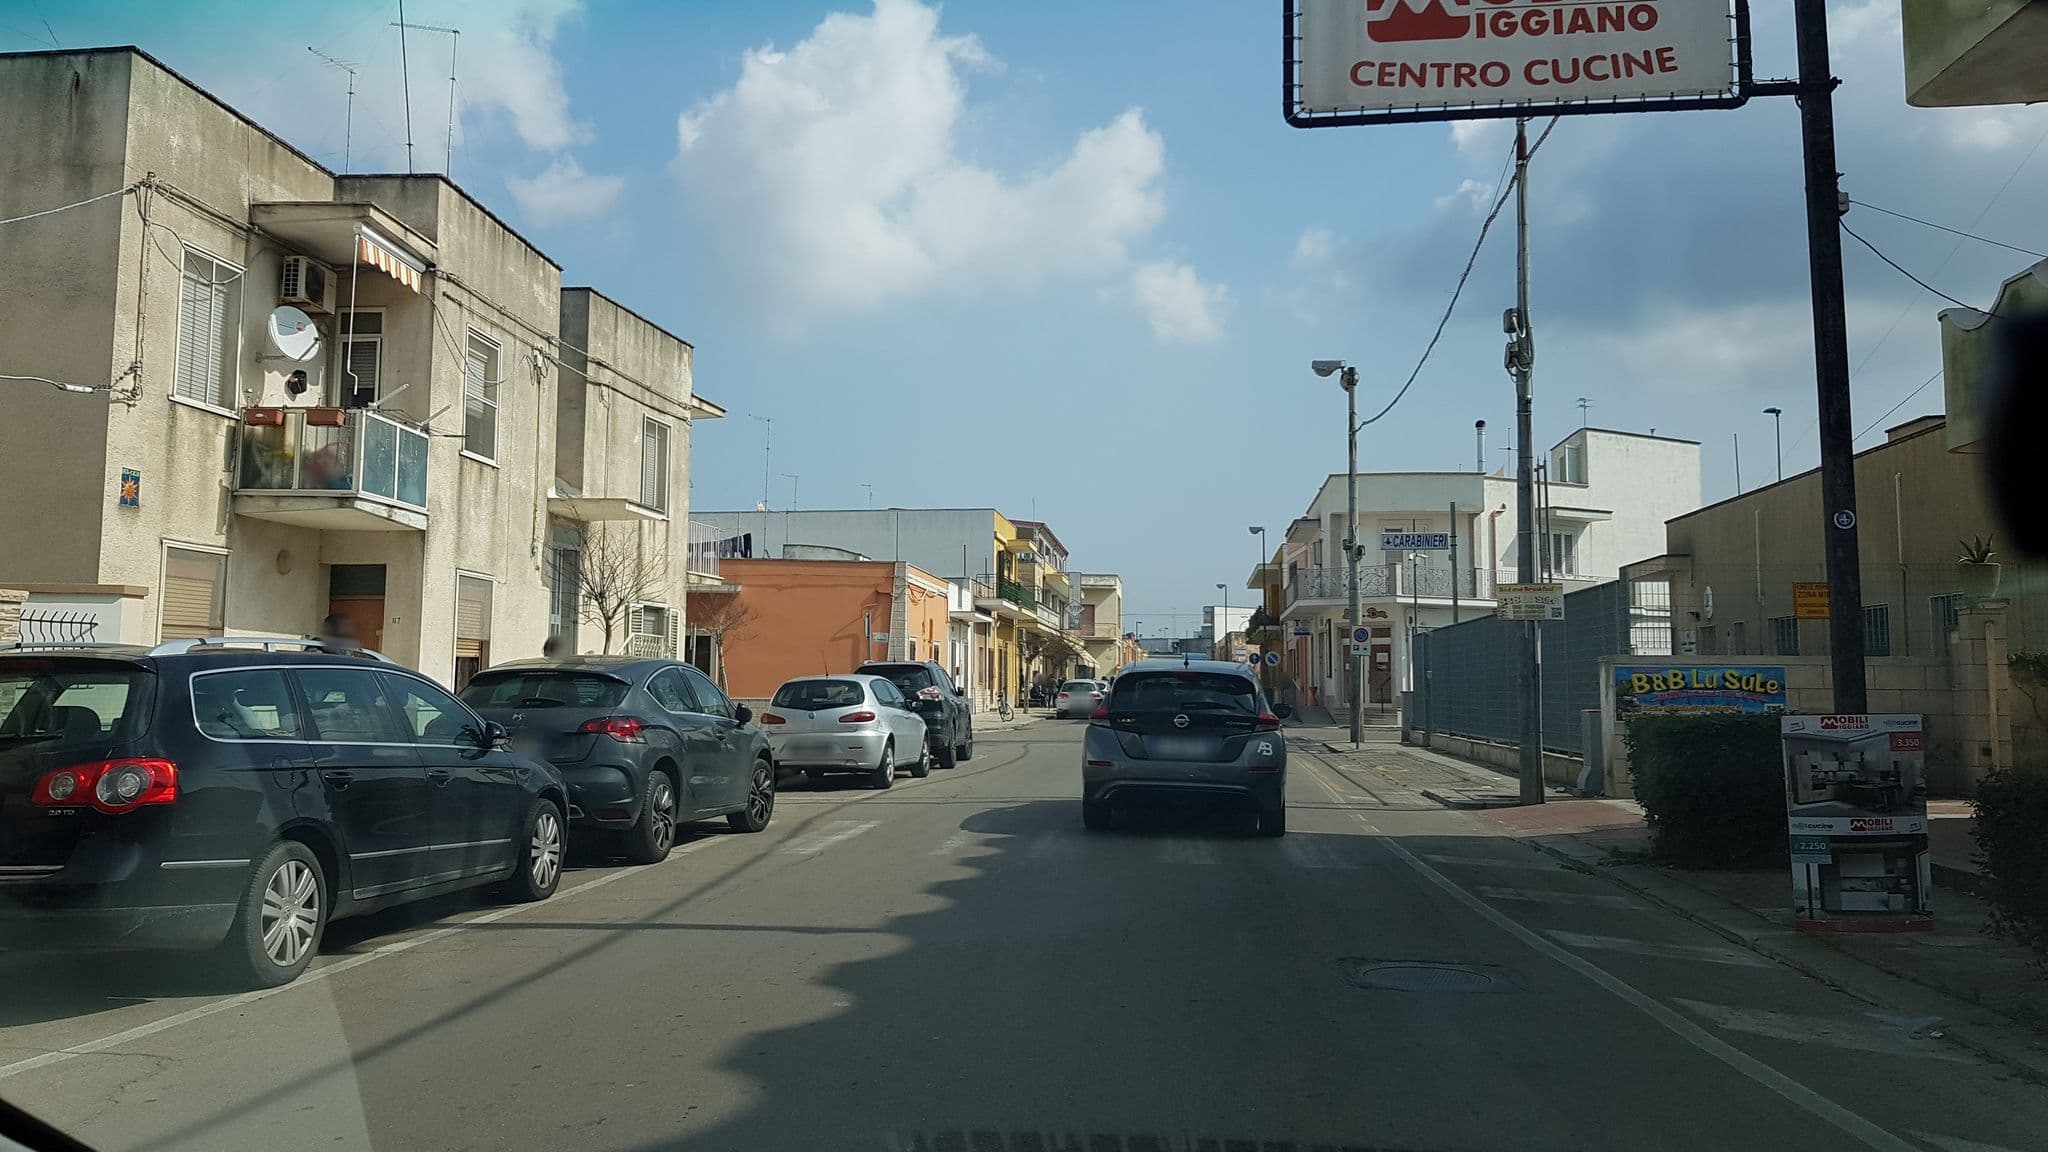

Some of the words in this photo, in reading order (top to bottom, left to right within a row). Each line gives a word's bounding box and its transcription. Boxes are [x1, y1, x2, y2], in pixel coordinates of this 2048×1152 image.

[1350, 61, 1510, 87] CENTRO
[1523, 46, 1678, 85] CUCINE
[1393, 534, 1448, 548] CARABINIERI
[1631, 669, 1686, 695] B&B
[1692, 669, 1717, 689] Lu
[1897, 738, 1920, 747] 3.350
[1800, 842, 1826, 850] 2.250
